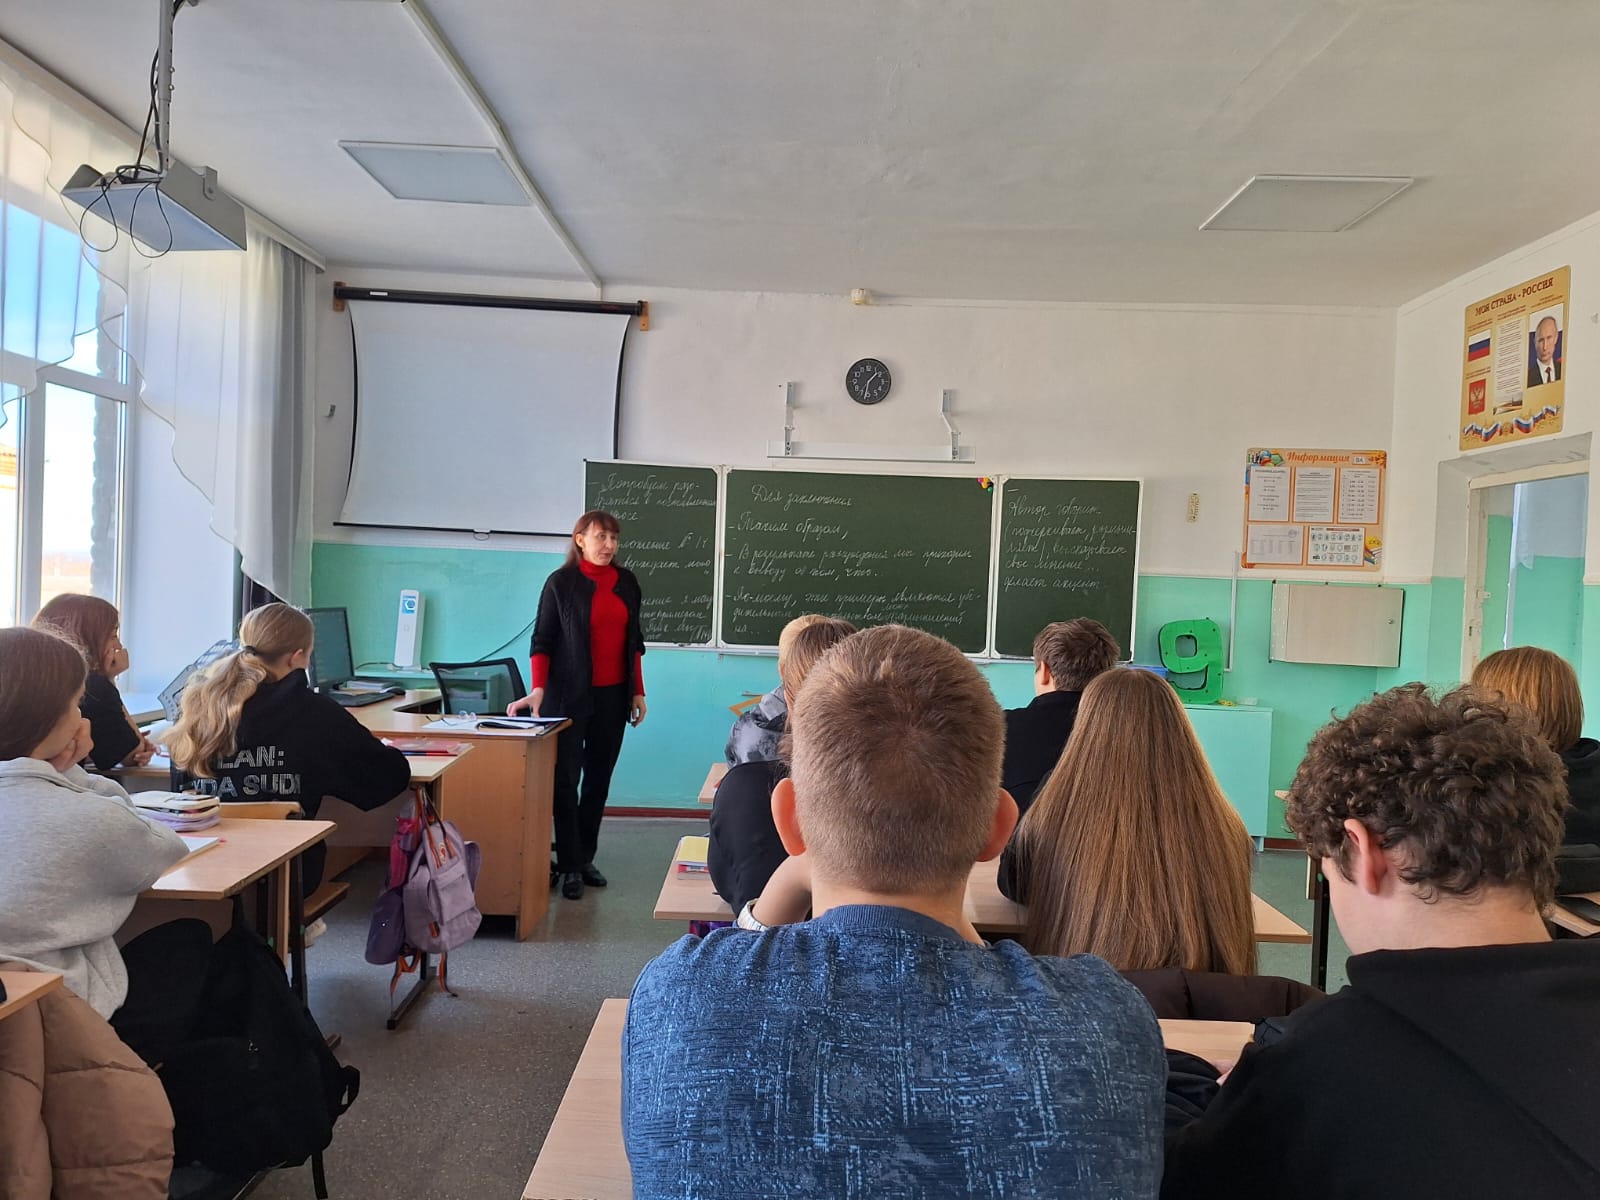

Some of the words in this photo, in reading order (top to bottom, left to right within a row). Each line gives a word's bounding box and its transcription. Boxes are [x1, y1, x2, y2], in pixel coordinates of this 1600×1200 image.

[1474, 304, 1491, 317] МОЯ
[1490, 293, 1517, 310] СТРАНА
[1521, 277, 1554, 298] РОССИЯ
[1287, 451, 1350, 463] Информация
[751, 483, 782, 502] Для
[1008, 495, 1051, 522] Автор
[738, 511, 788, 531] Таким
[795, 518, 848, 543] образом,
[739, 543, 749, 560] В
[217, 746, 285, 769] LAN:
